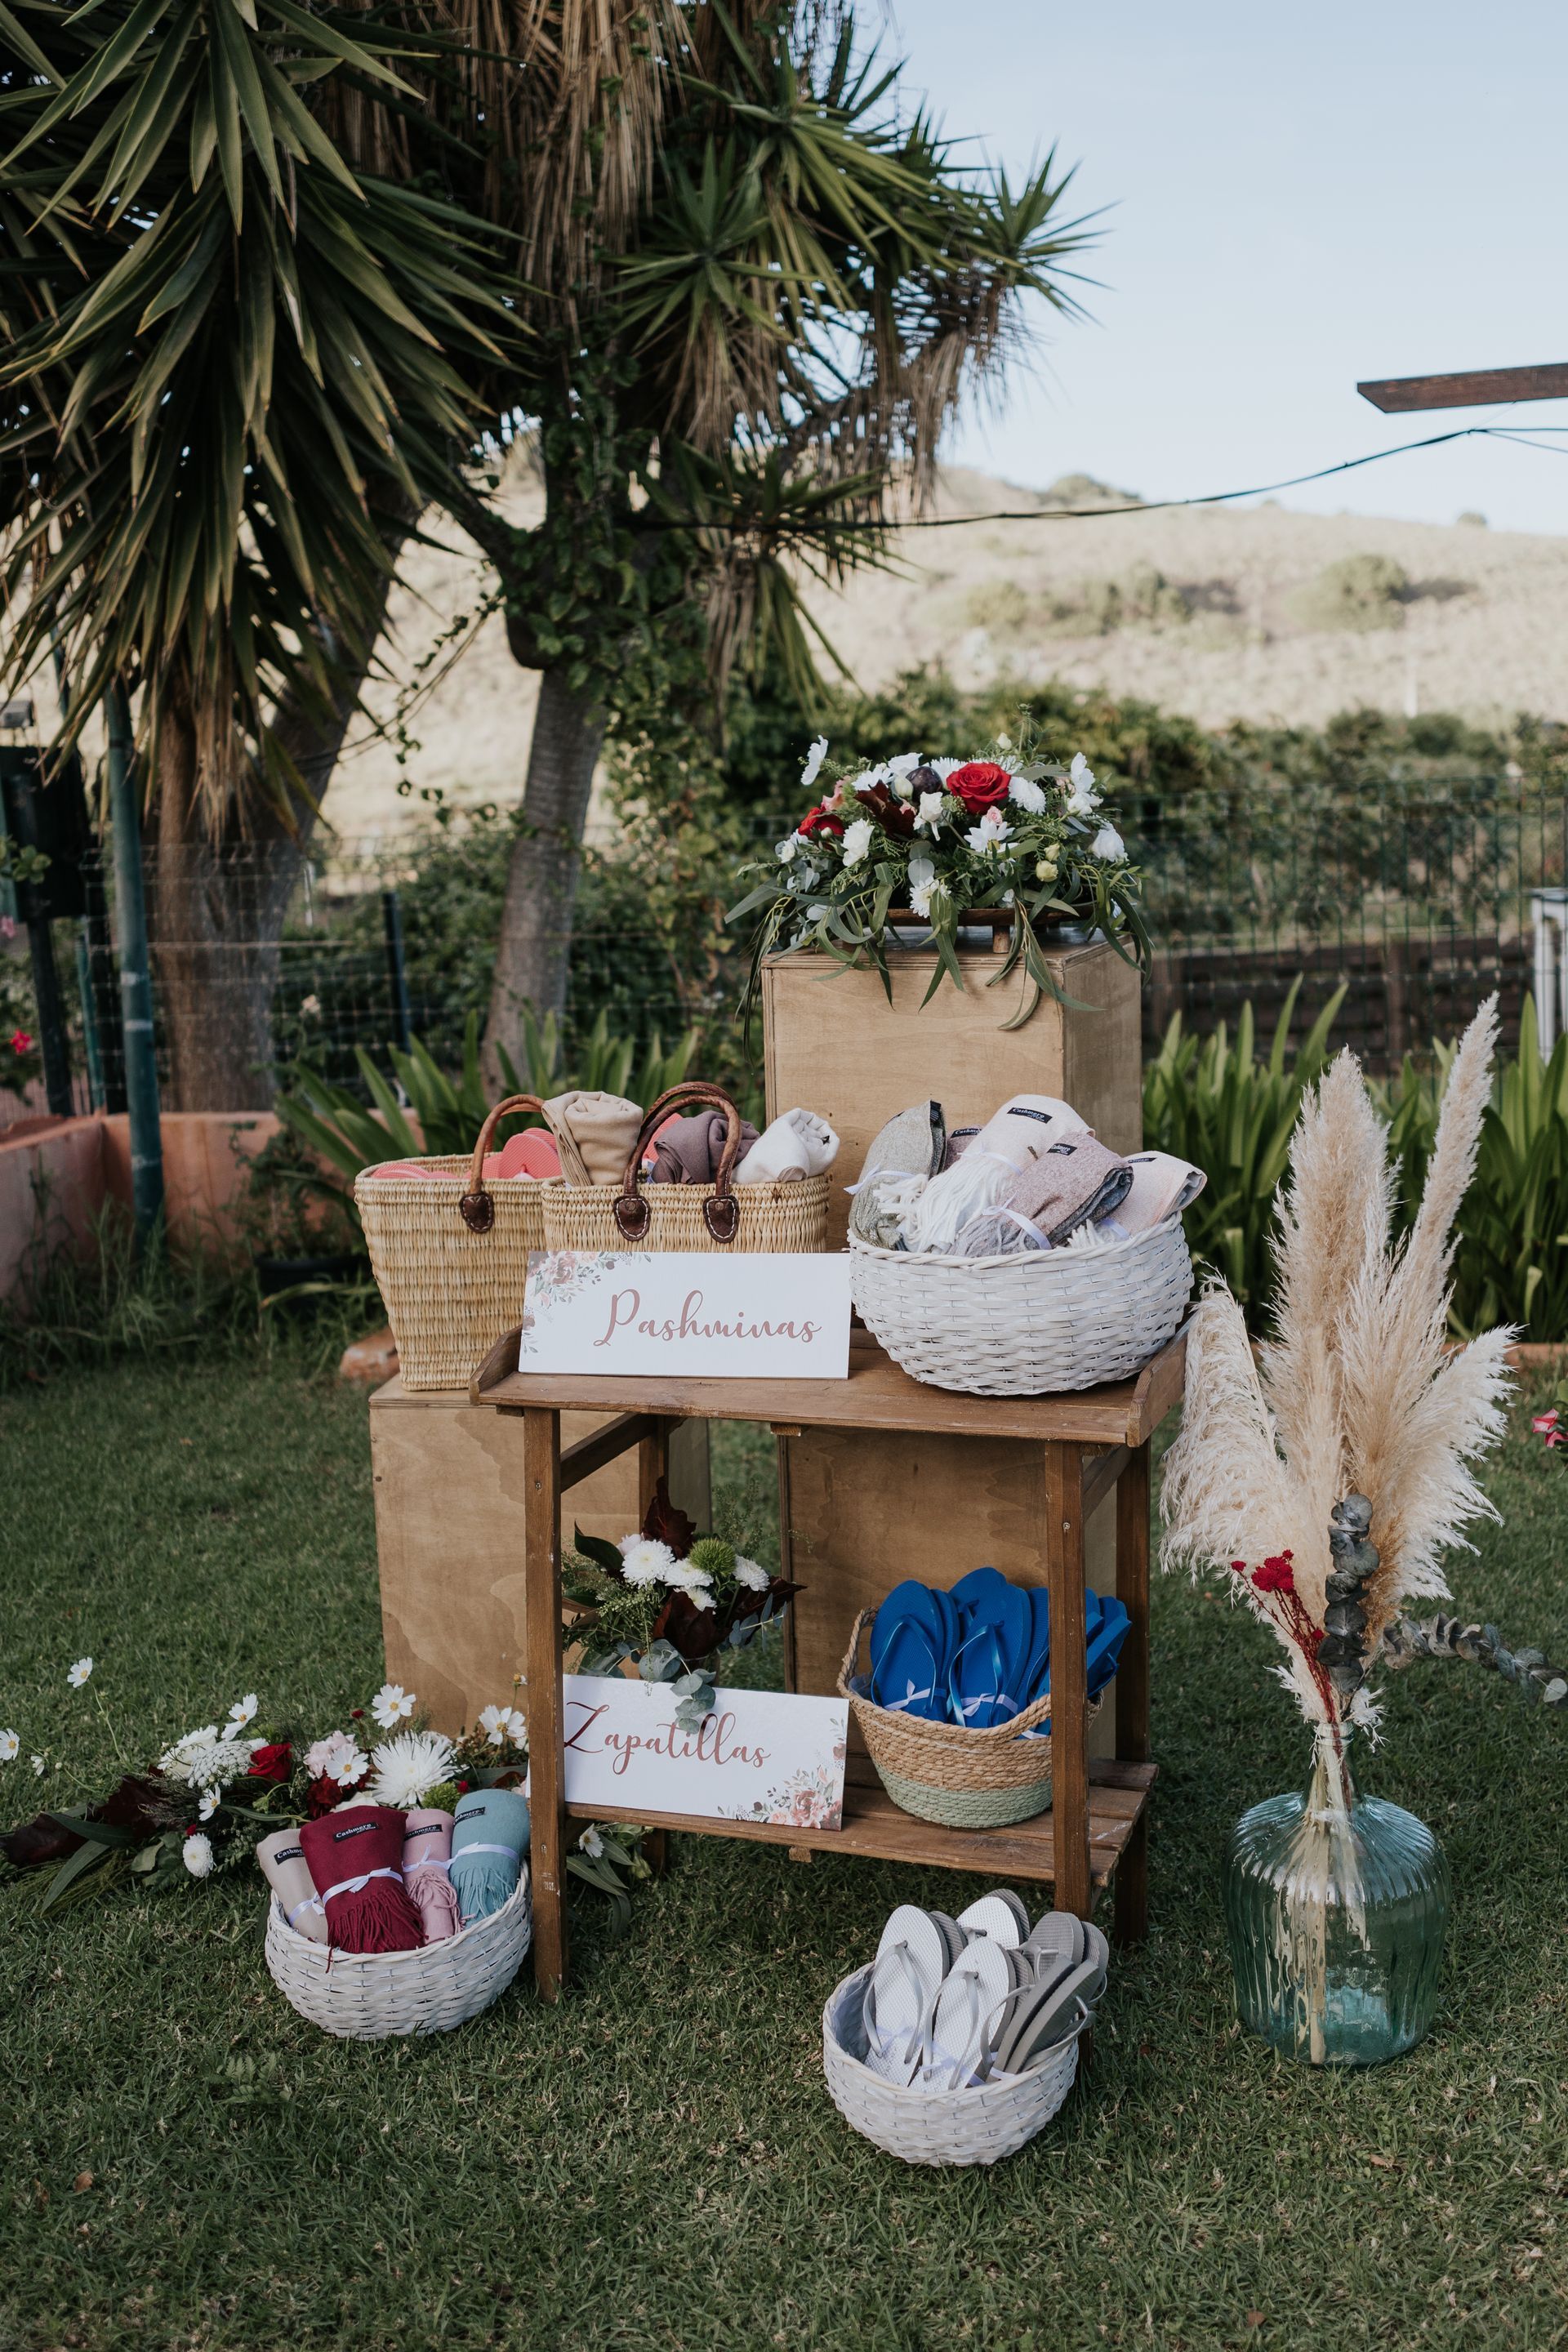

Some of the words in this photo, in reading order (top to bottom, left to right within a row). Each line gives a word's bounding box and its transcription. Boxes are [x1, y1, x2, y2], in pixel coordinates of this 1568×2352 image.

[1012, 1108, 1045, 1118] Cashmere
[593, 1288, 822, 1347] Pashminas
[564, 1701, 772, 1775] Zapatillas
[336, 1823, 372, 1838] Cashmere
